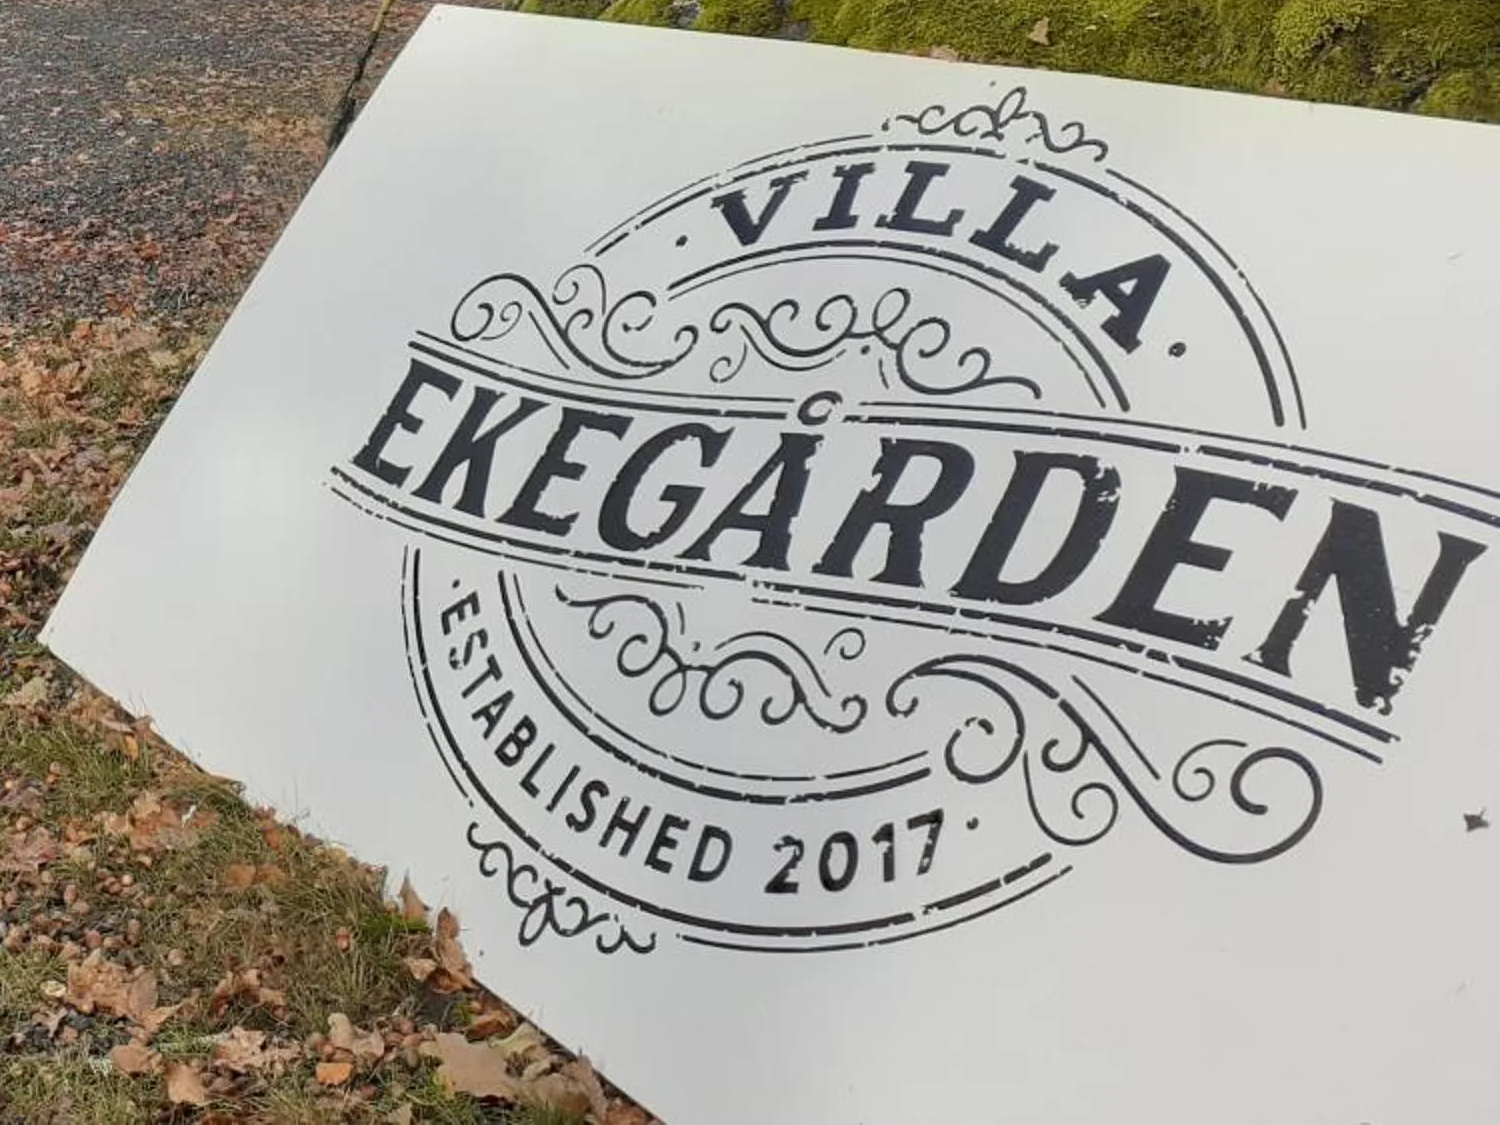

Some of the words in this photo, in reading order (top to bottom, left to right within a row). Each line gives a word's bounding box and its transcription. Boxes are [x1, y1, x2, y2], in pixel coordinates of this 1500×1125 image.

[710, 160, 1171, 355] VILLA
[352, 358, 1487, 716] EKEGÅRDEN
[439, 591, 733, 883] ESTABLISHED
[764, 808, 947, 895] 2017
